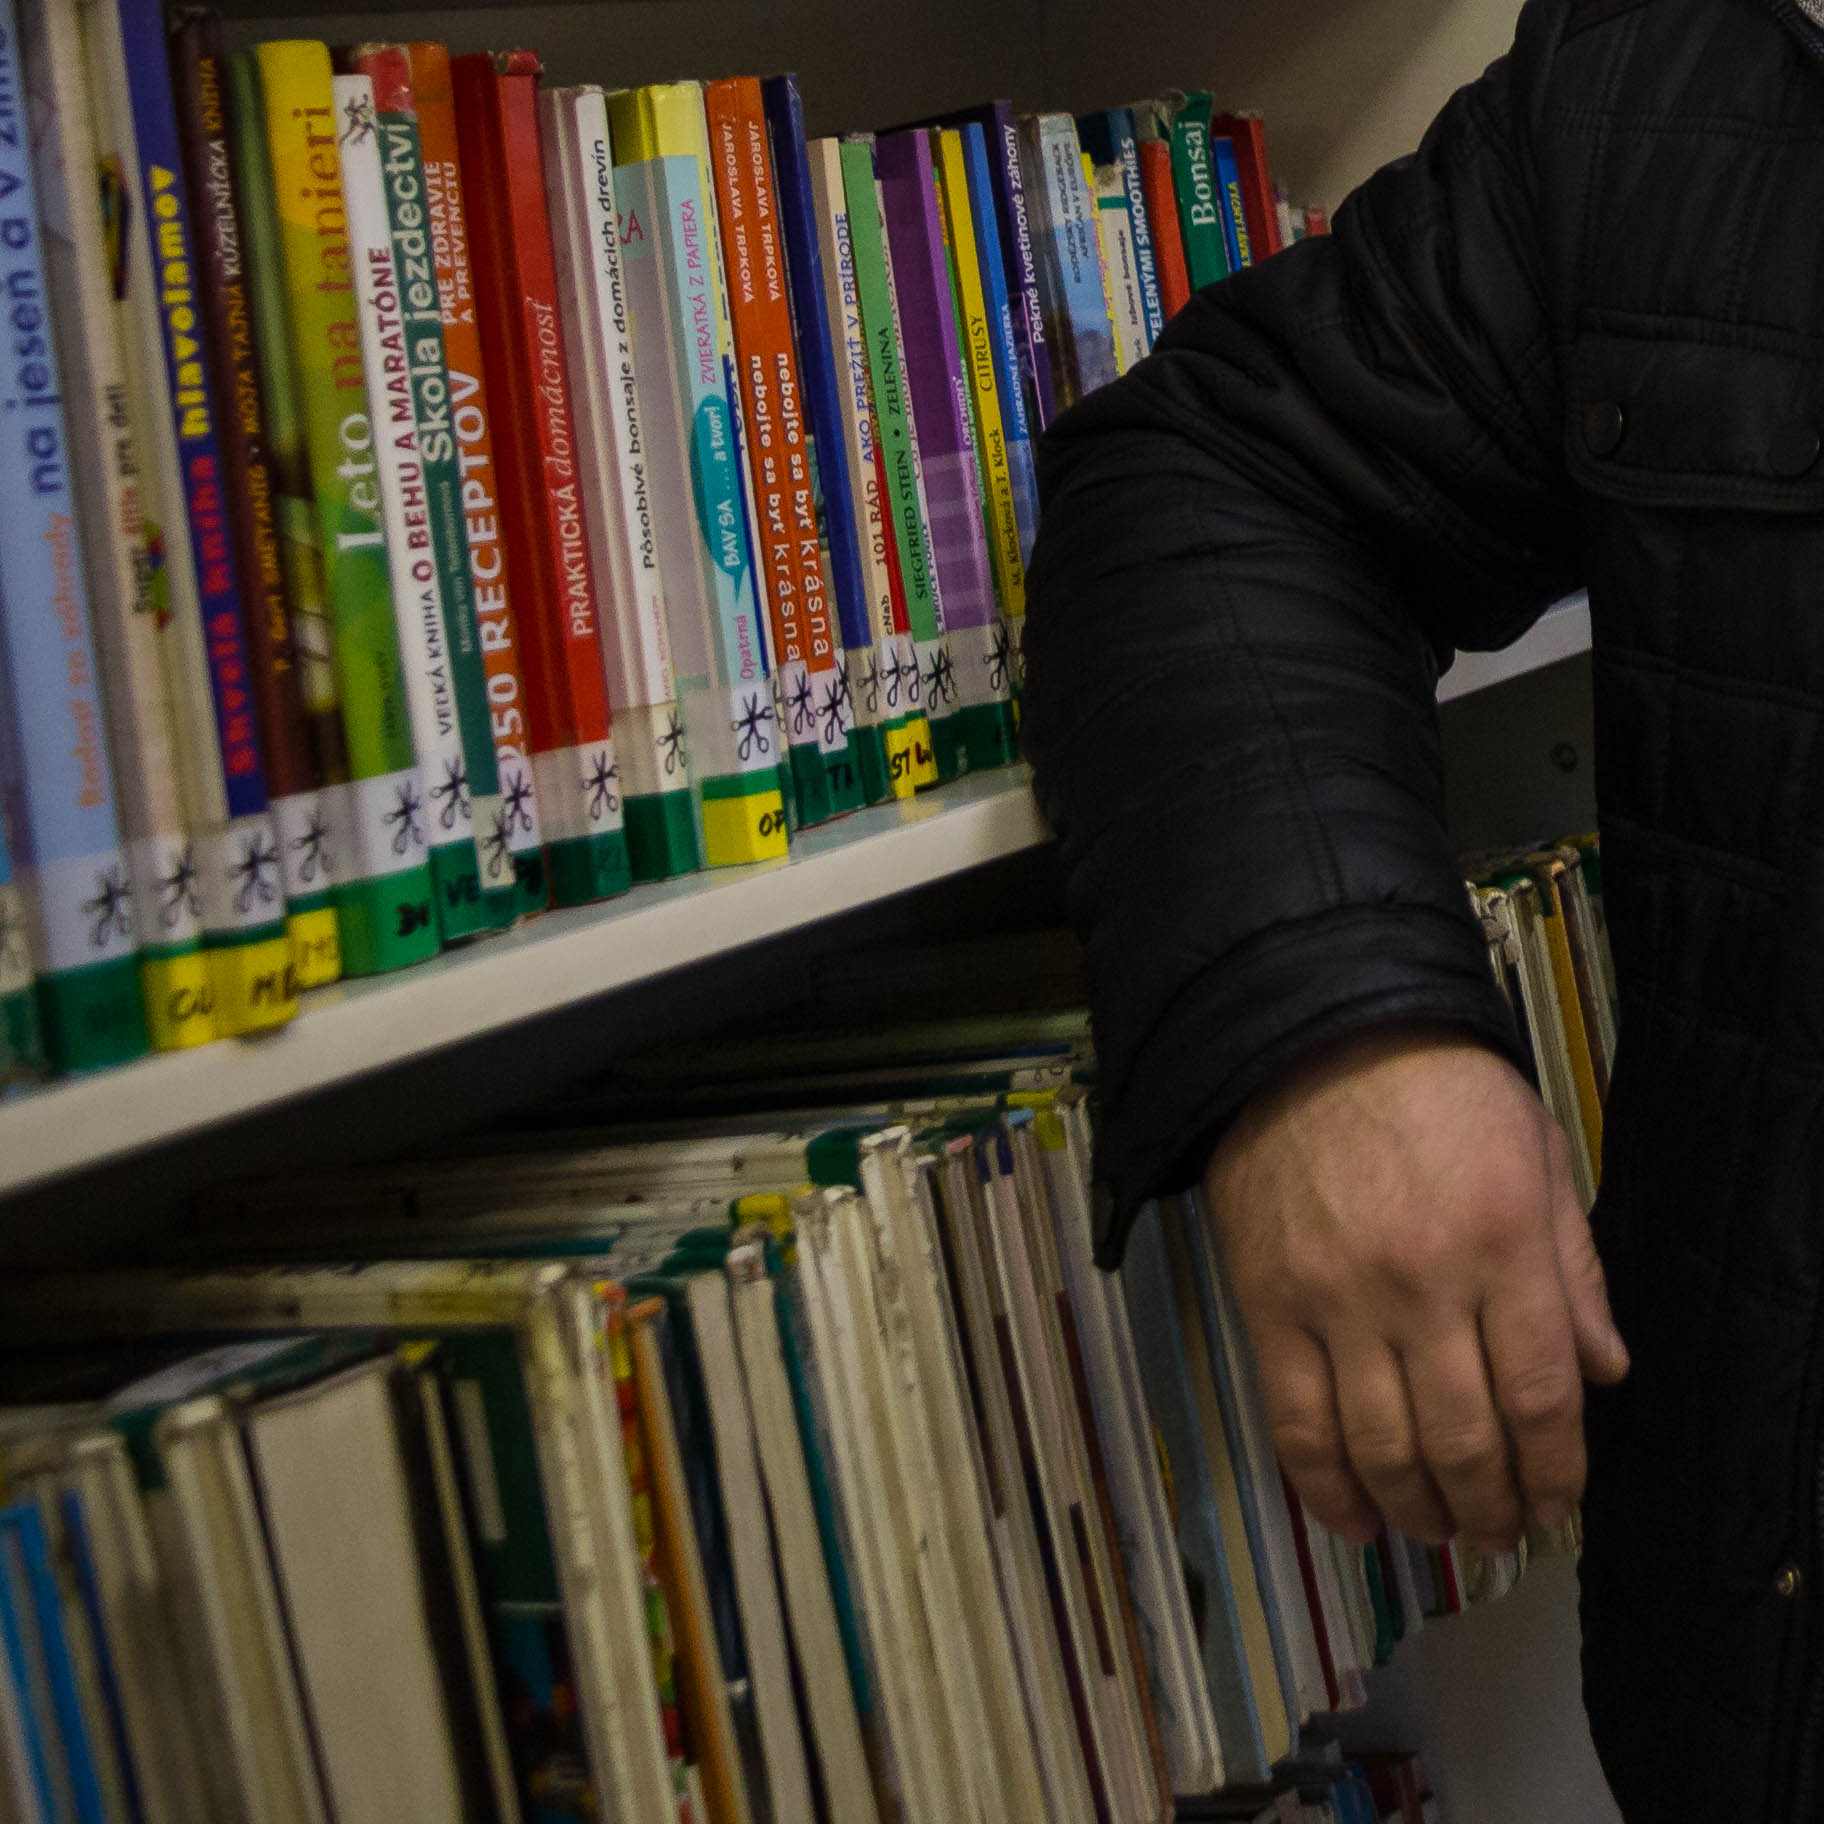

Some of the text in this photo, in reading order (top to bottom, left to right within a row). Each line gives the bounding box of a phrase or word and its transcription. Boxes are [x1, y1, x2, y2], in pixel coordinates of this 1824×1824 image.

[199, 56, 222, 131] KNIHA
[720, 117, 746, 218] JAROSLAVA
[747, 119, 773, 222] JAROSLAVA
[1177, 118, 1218, 226] Bonsaj
[378, 123, 443, 323] jezdectví
[423, 160, 457, 324] PRE ZDRAVIE
[442, 160, 473, 324] A PREVENCIU
[1000, 123, 1047, 344] Pekné kvetinové záhony
[1120, 136, 1166, 340] ZELENÝMI SMOOTHIES
[2, 269, 60, 408] jeseň
[150, 163, 212, 438] hlavolamov
[219, 284, 251, 362] TAJNÁ
[292, 106, 386, 551] Leto na tanieri
[367, 246, 413, 423] MARATÓNE
[679, 197, 718, 385] ZVIERATKÁ Z PAPIERA
[235, 370, 260, 434] MOJA
[589, 138, 656, 570] Pôsobivé bonsaje z domácich drevín
[748, 353, 774, 447] nebojte
[775, 351, 801, 445] nebojte
[830, 211, 888, 566] 101 RÁD AKO PREŽIŤ V PRÍRODE
[876, 326, 901, 415] ZELENINA
[26, 427, 63, 495] na
[394, 430, 417, 452] A
[525, 295, 594, 636] PRAKTICKÁ domácnosť
[761, 456, 777, 484] sa
[787, 452, 805, 481] sa
[893, 448, 916, 502] STEIN
[969, 314, 1020, 565] Klocková a Klock CITRUSY
[398, 461, 430, 549] BEHU
[448, 368, 513, 653] RECEPTOV
[718, 498, 738, 528] SA
[722, 529, 742, 568] BAV
[764, 492, 787, 534] byť
[790, 488, 815, 531] byť
[901, 504, 930, 601] SIEGFRIED
[412, 558, 434, 583] O
[774, 540, 803, 663] krásna
[801, 538, 830, 657] krásna
[418, 588, 445, 660] KNIHA
[732, 615, 757, 681] Opatrná
